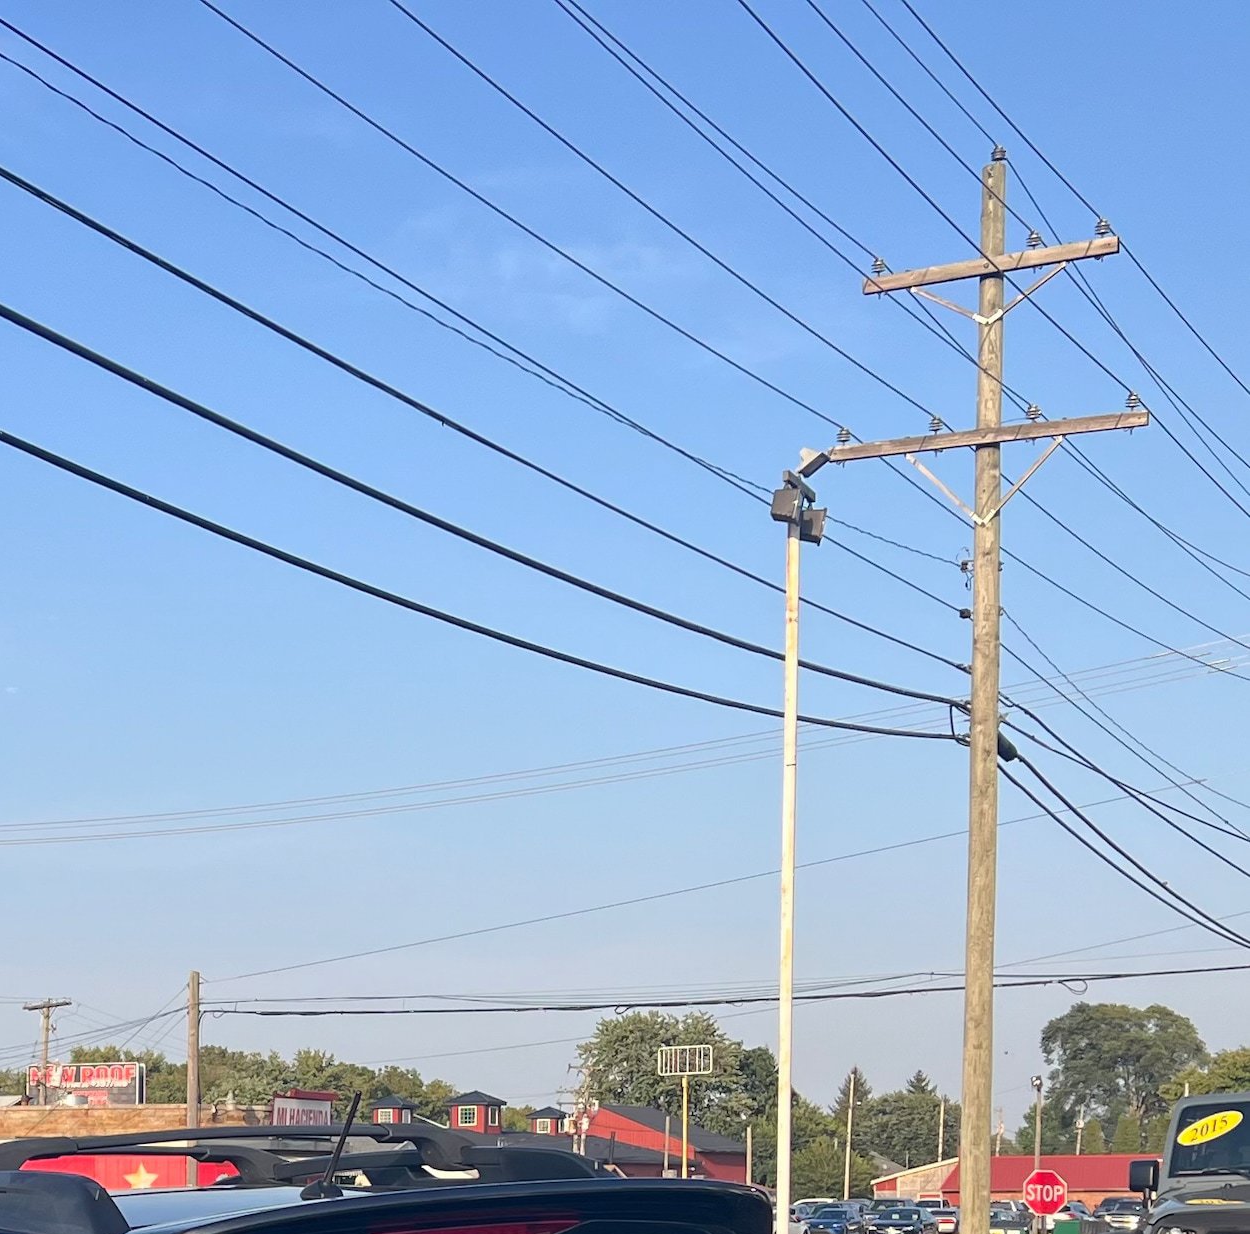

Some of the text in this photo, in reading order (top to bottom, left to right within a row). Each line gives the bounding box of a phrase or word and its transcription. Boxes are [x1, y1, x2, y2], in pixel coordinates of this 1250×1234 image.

[81, 1065, 136, 1083] ROOF
[1190, 1116, 1229, 1142] 2015
[1026, 1184, 1064, 1202] STOP
